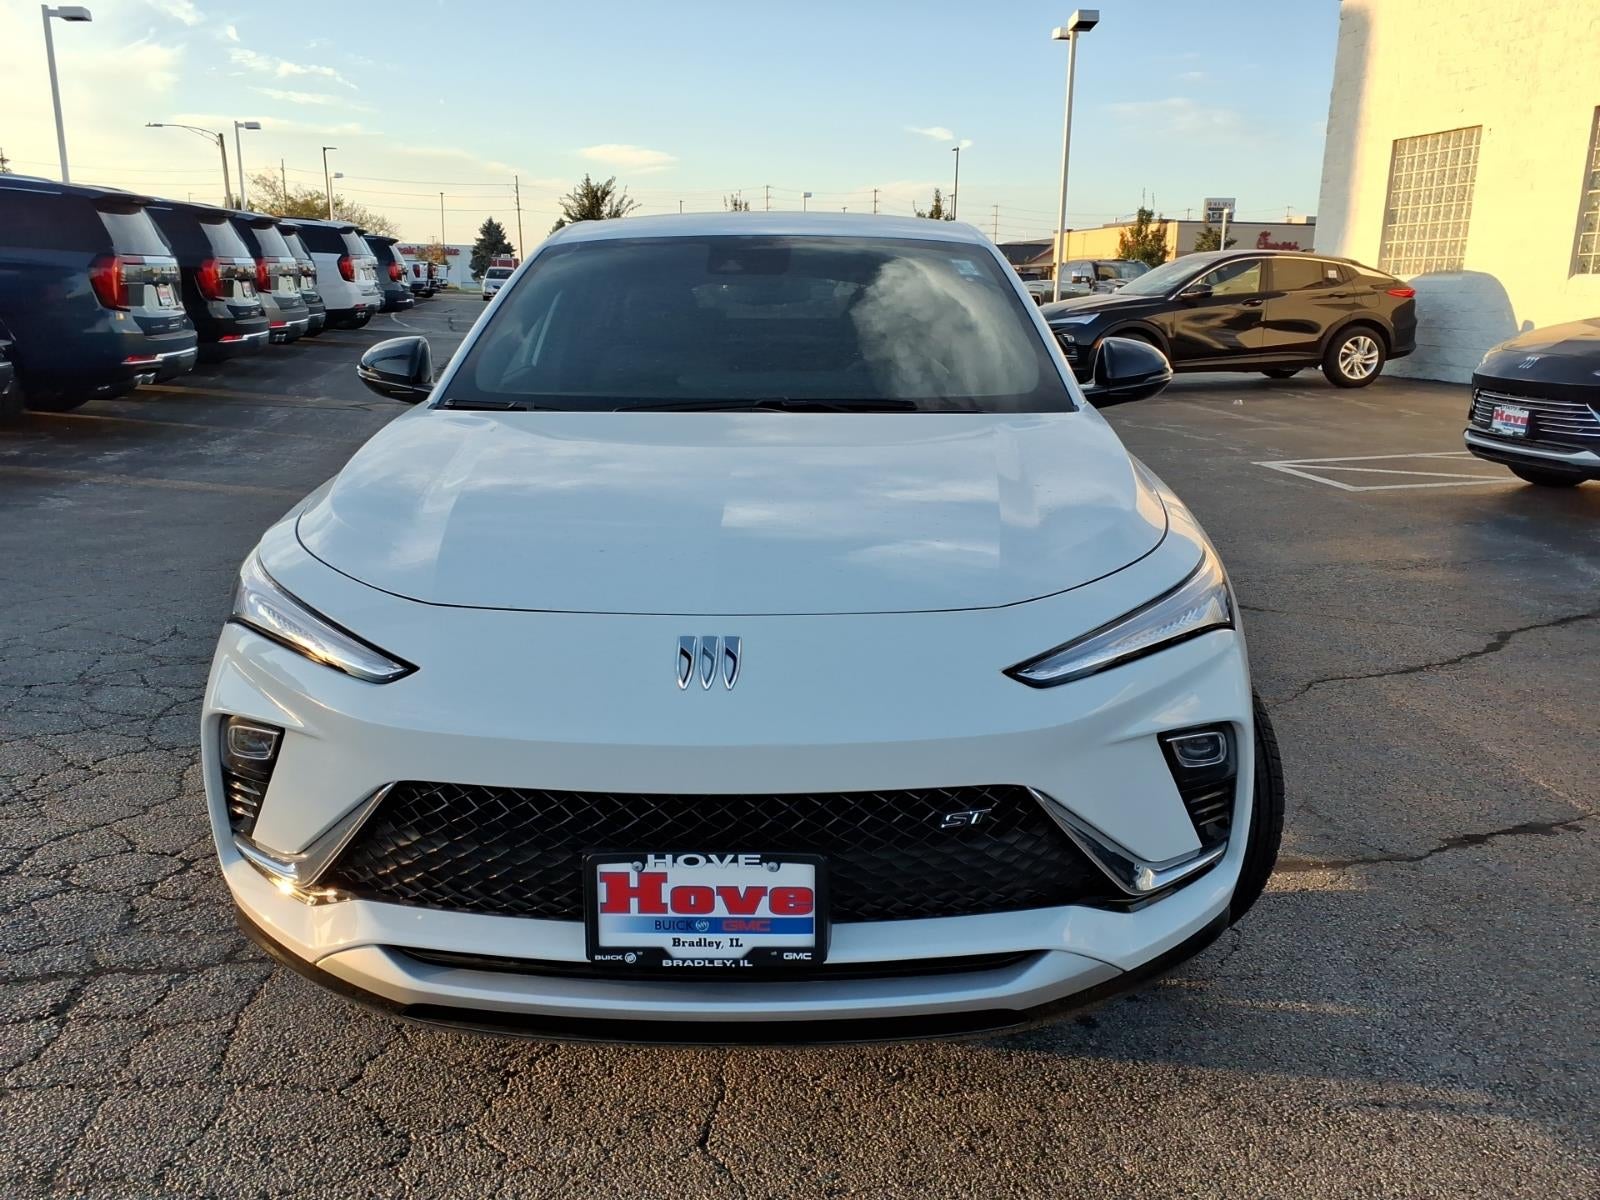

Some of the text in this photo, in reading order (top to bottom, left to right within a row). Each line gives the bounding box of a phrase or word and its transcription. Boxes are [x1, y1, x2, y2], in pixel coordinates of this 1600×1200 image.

[941, 808, 992, 828] ST
[647, 854, 762, 869] HOVE
[599, 872, 814, 915] Hove
[654, 919, 771, 931] BUICK GMC
[672, 937, 743, 950] Bradley, IL
[783, 952, 812, 960] GMC
[662, 960, 736, 968] BRADLEY,
